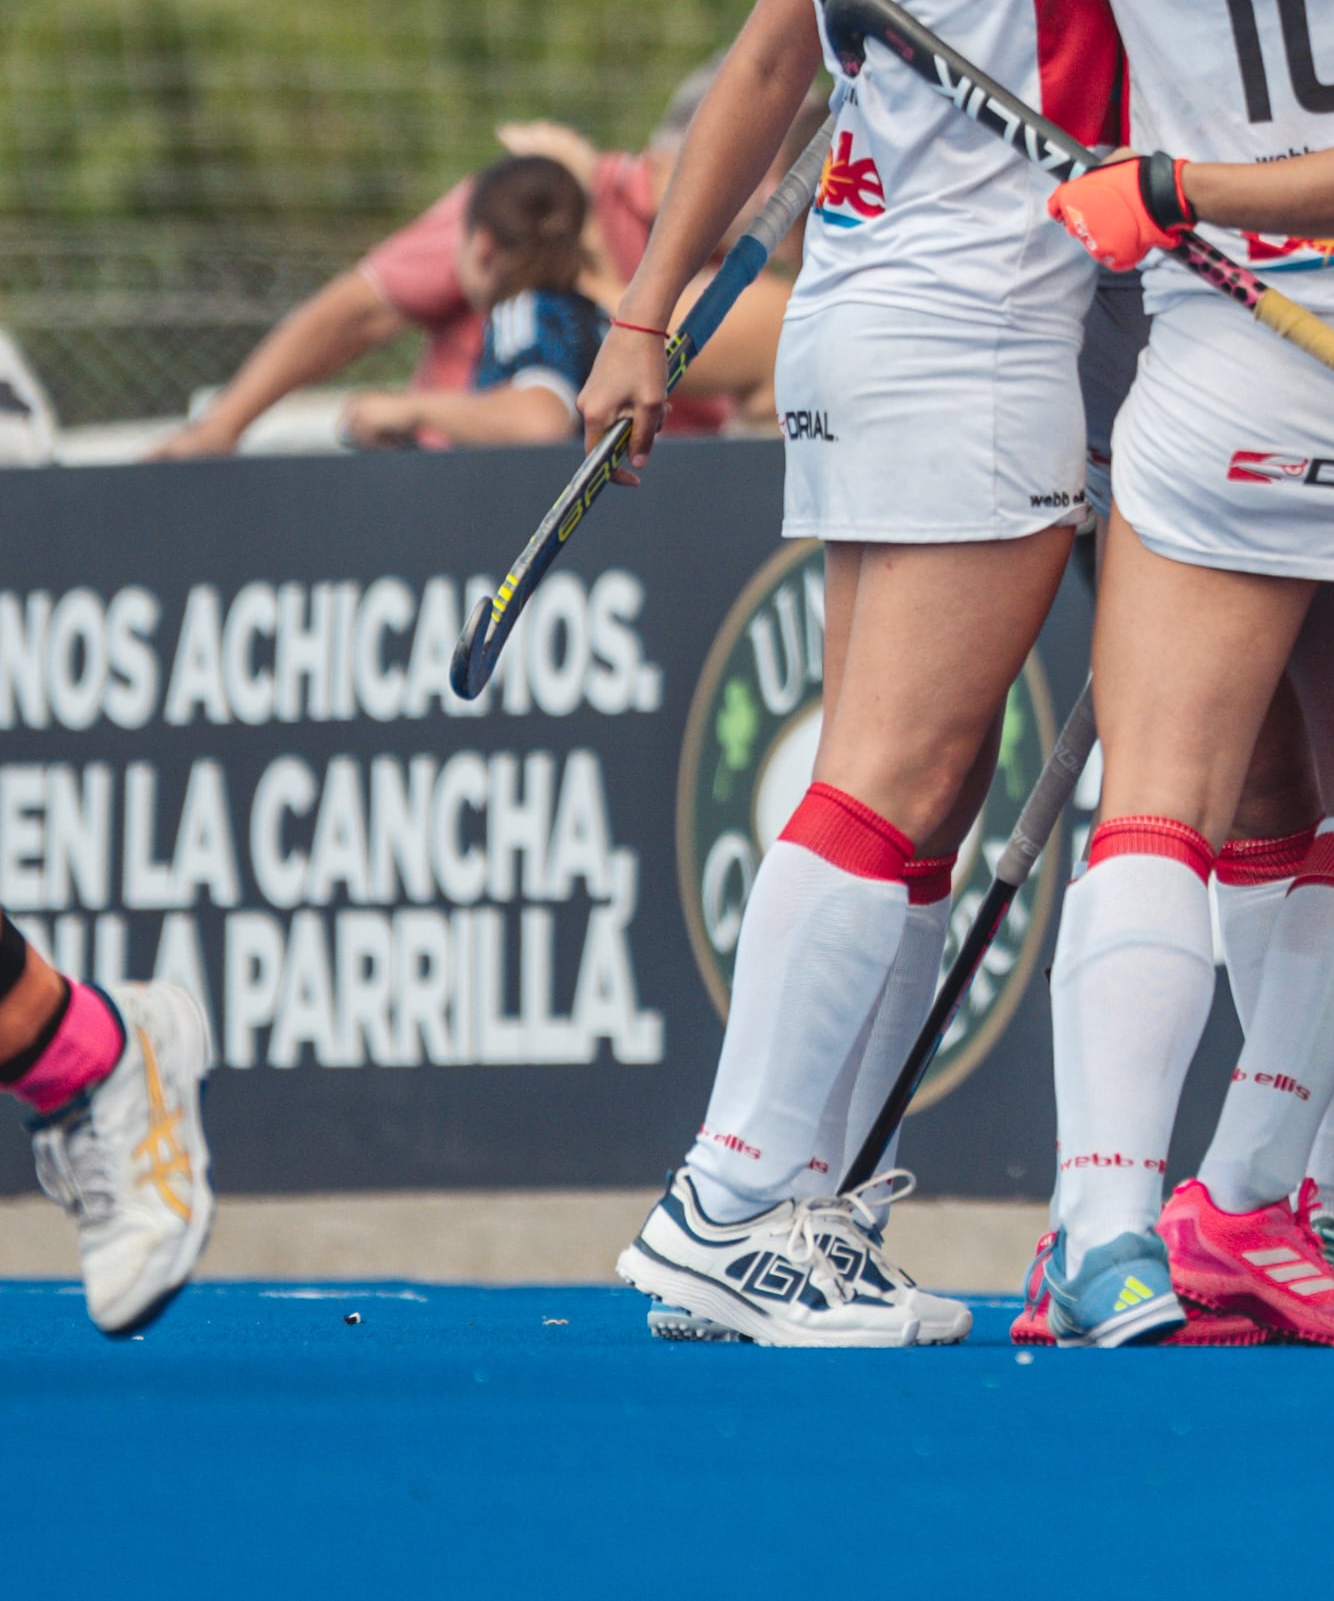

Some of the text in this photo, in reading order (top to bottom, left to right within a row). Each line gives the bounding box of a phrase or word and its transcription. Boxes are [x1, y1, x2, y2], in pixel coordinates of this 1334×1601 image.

[931, 52, 1088, 182] ALIK
[0, 584, 161, 731] NOS
[0, 760, 113, 911] EN
[122, 758, 241, 910] LA
[249, 748, 641, 930] CANCHA,
[223, 906, 664, 1069] PARRILLA.
[713, 1133, 762, 1160] ellis
[1254, 1071, 1311, 1102] ellis
